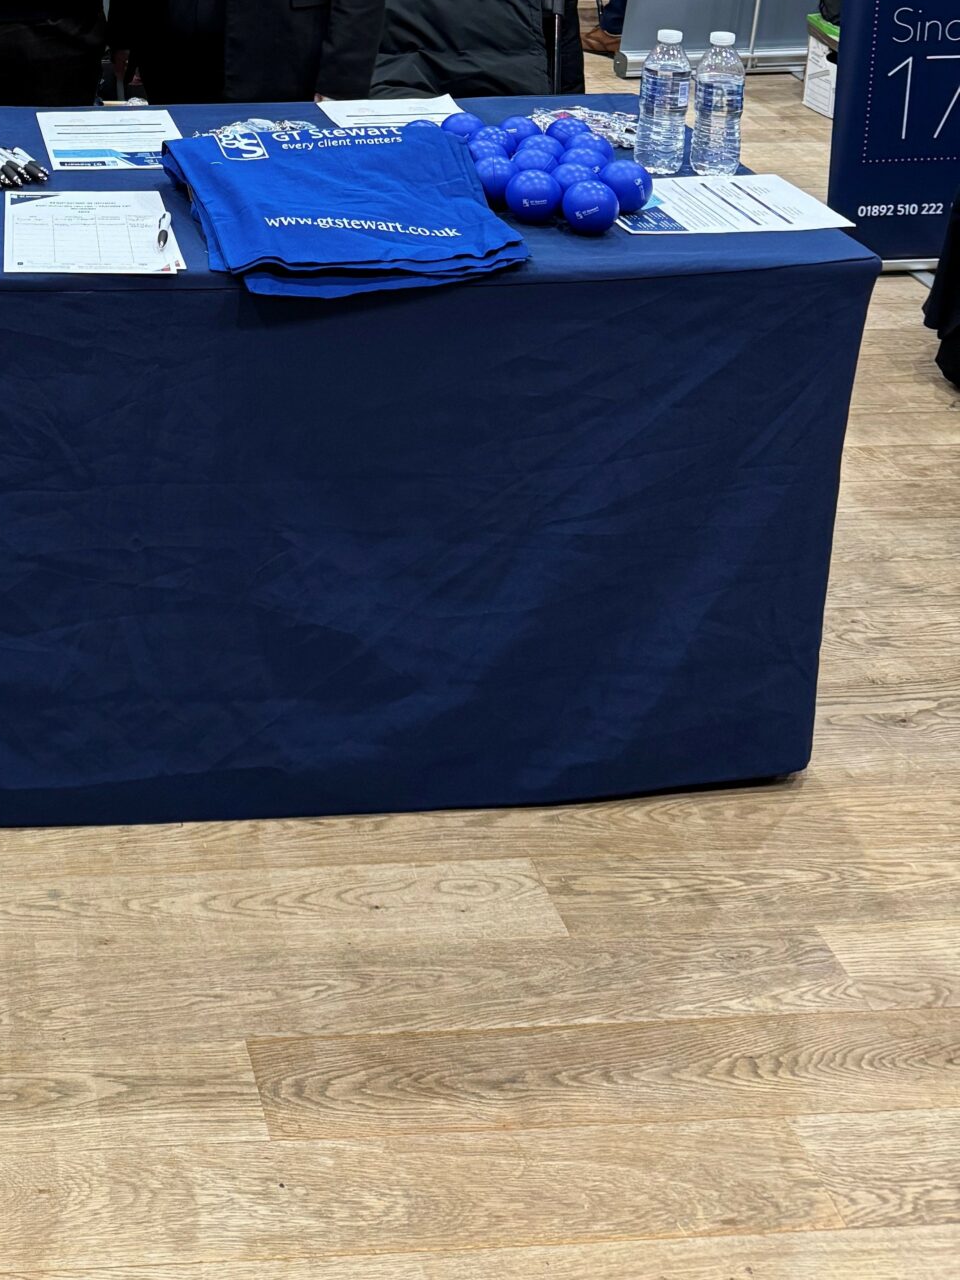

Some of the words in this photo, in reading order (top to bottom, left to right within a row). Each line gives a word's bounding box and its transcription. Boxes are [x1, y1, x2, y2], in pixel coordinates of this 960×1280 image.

[272, 130, 301, 142] GT
[309, 127, 403, 139] Stewart
[282, 141, 315, 150] every
[318, 137, 352, 148] client
[355, 136, 403, 145] matters
[858, 205, 894, 217] 01892
[897, 204, 918, 216] 510
[921, 203, 944, 215] 222
[265, 216, 462, 237] www.gtstewart.co.uk
